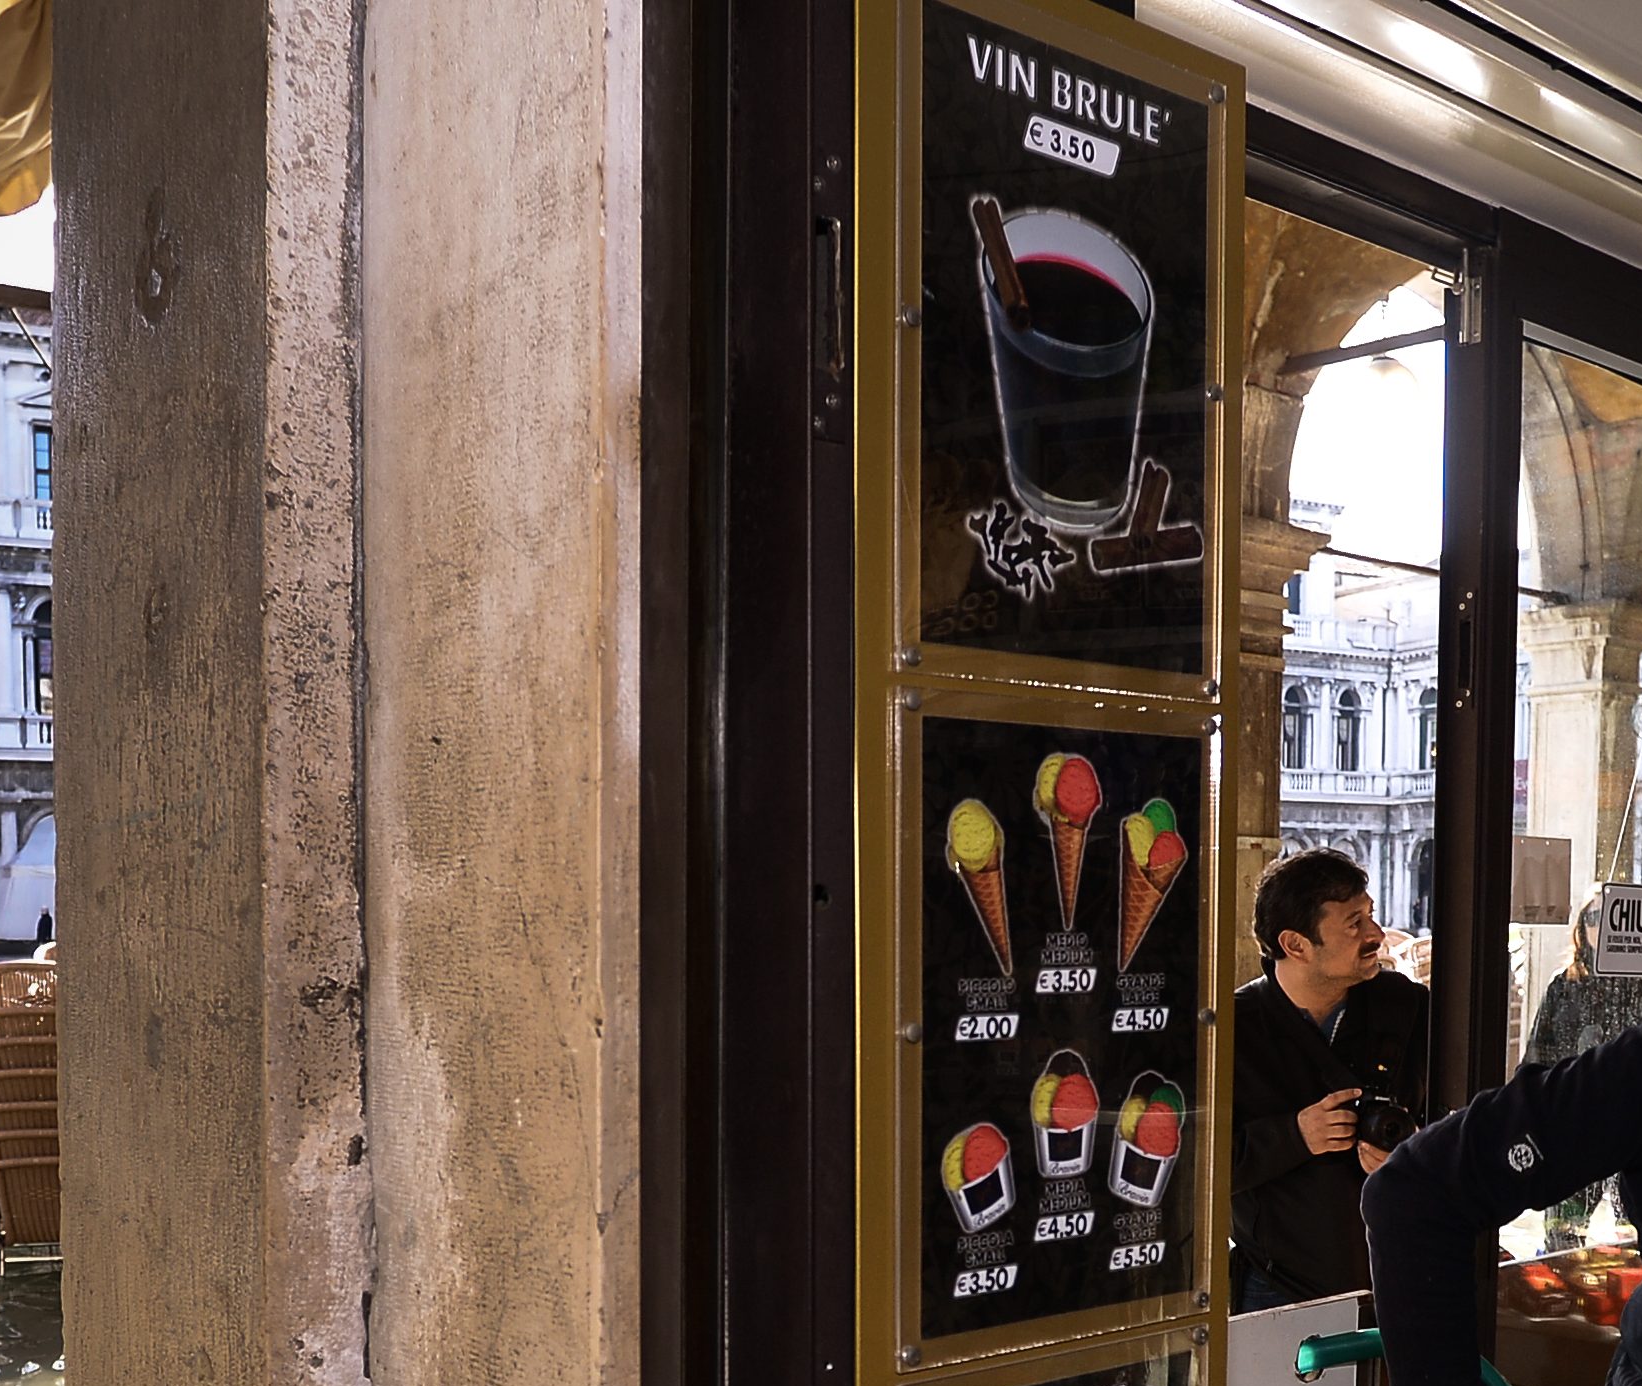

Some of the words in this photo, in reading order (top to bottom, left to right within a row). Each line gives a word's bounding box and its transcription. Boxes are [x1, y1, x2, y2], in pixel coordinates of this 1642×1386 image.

[968, 35, 1036, 99] VIN
[1046, 933, 1087, 948] MEDIO
[1041, 950, 1093, 964] MEDIUM
[958, 978, 1016, 994] PICCOLO
[1116, 973, 1165, 989] GRANDE
[966, 994, 1007, 1010] SMALL
[1121, 990, 1159, 1005] LARGE
[1044, 1178, 1087, 1195] MEDIA
[1039, 1194, 1091, 1214] MEDIUM
[1114, 1209, 1162, 1229] GRANDE
[957, 1230, 1014, 1250] PICCOLA
[1119, 1226, 1157, 1244] LARGE
[965, 1250, 1006, 1267] SMALL
